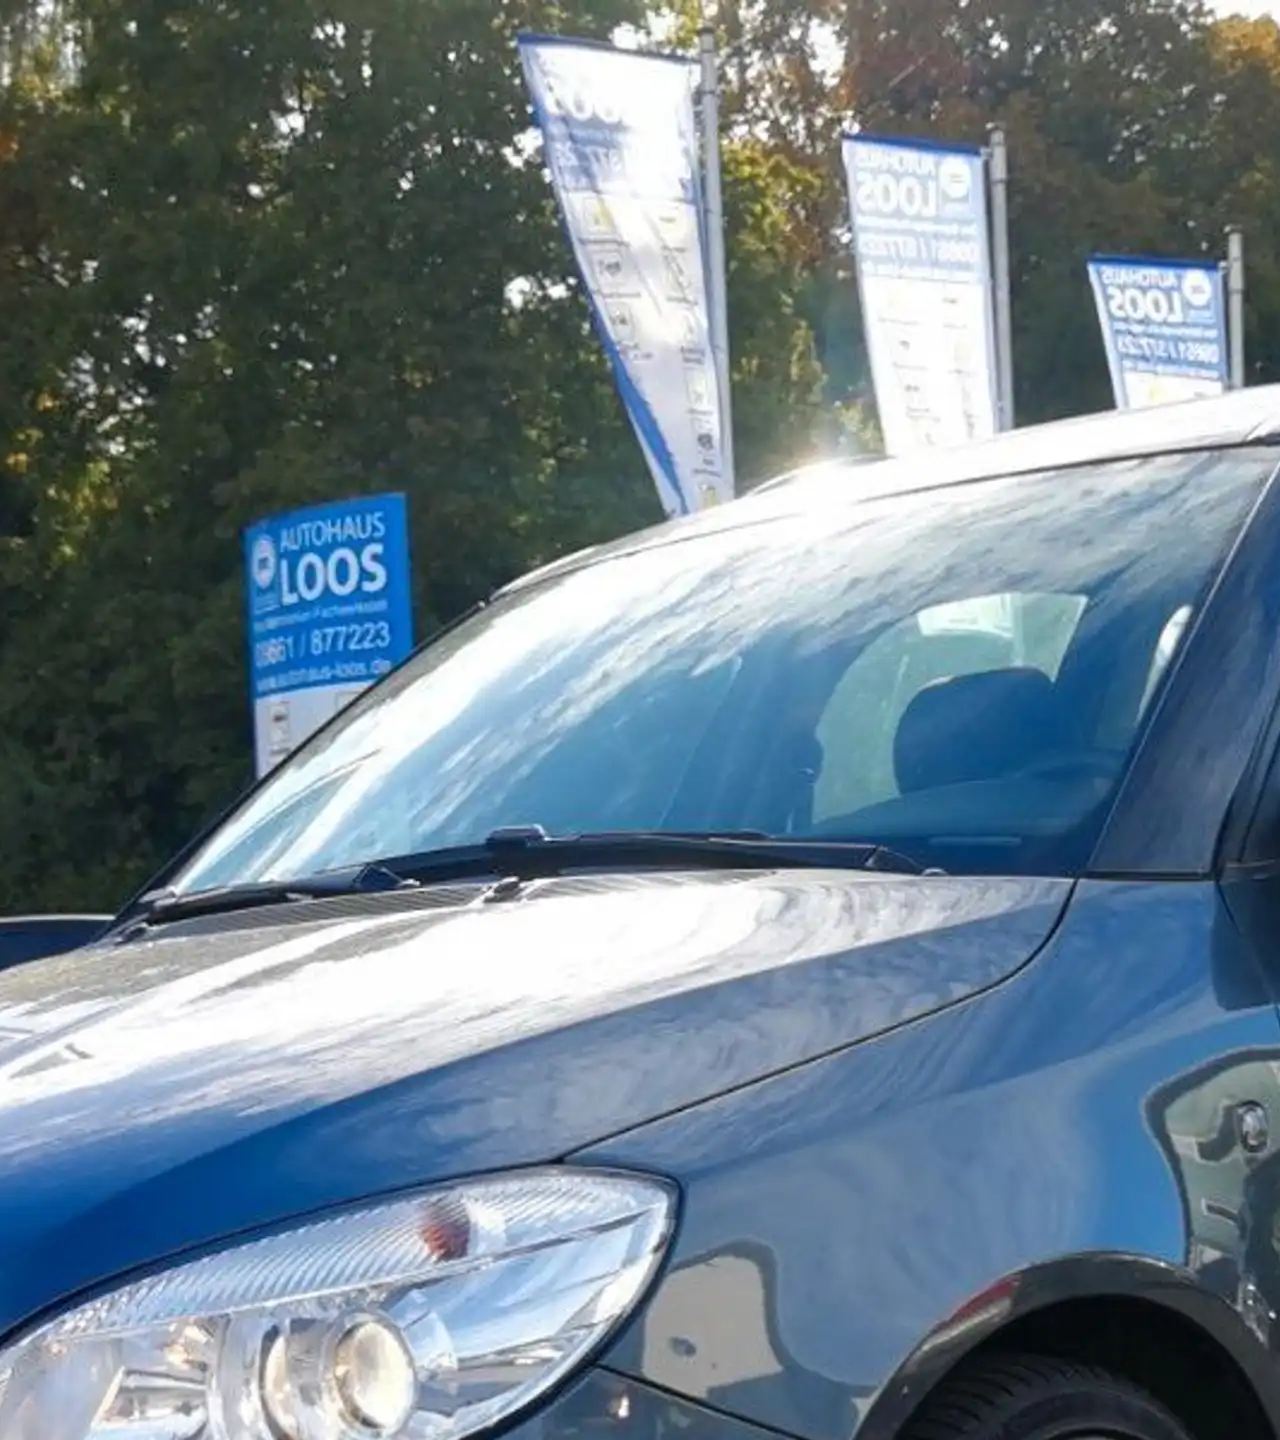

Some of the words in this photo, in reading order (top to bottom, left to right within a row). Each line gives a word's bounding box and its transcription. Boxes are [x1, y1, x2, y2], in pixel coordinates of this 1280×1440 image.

[280, 511, 386, 552] AUTOHAUS
[280, 542, 388, 606] LOOS
[311, 621, 390, 656] 877223
